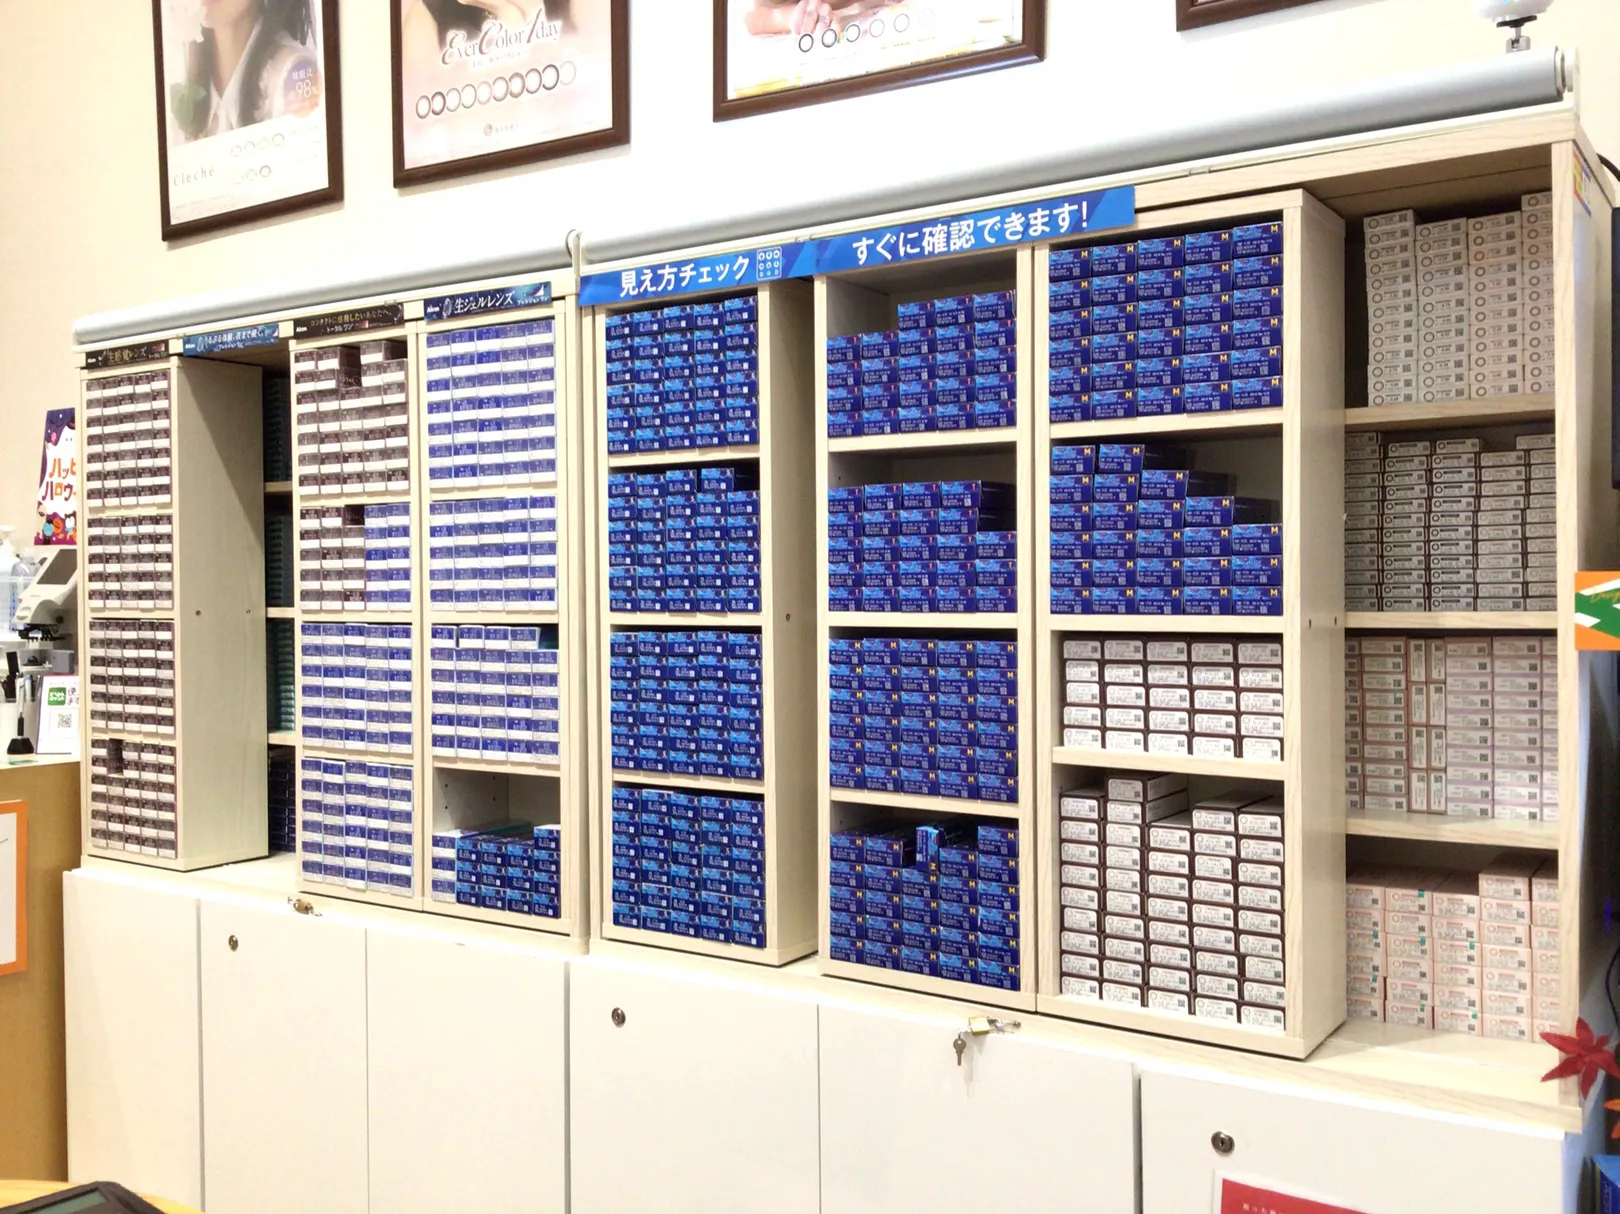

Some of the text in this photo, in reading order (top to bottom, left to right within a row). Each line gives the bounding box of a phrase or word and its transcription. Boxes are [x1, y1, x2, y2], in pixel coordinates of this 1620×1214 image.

[620, 256, 750, 299] 見え方チェック
[454, 291, 515, 314] 生ジェルレンズ
[42, 480, 76, 502] ハロウ
